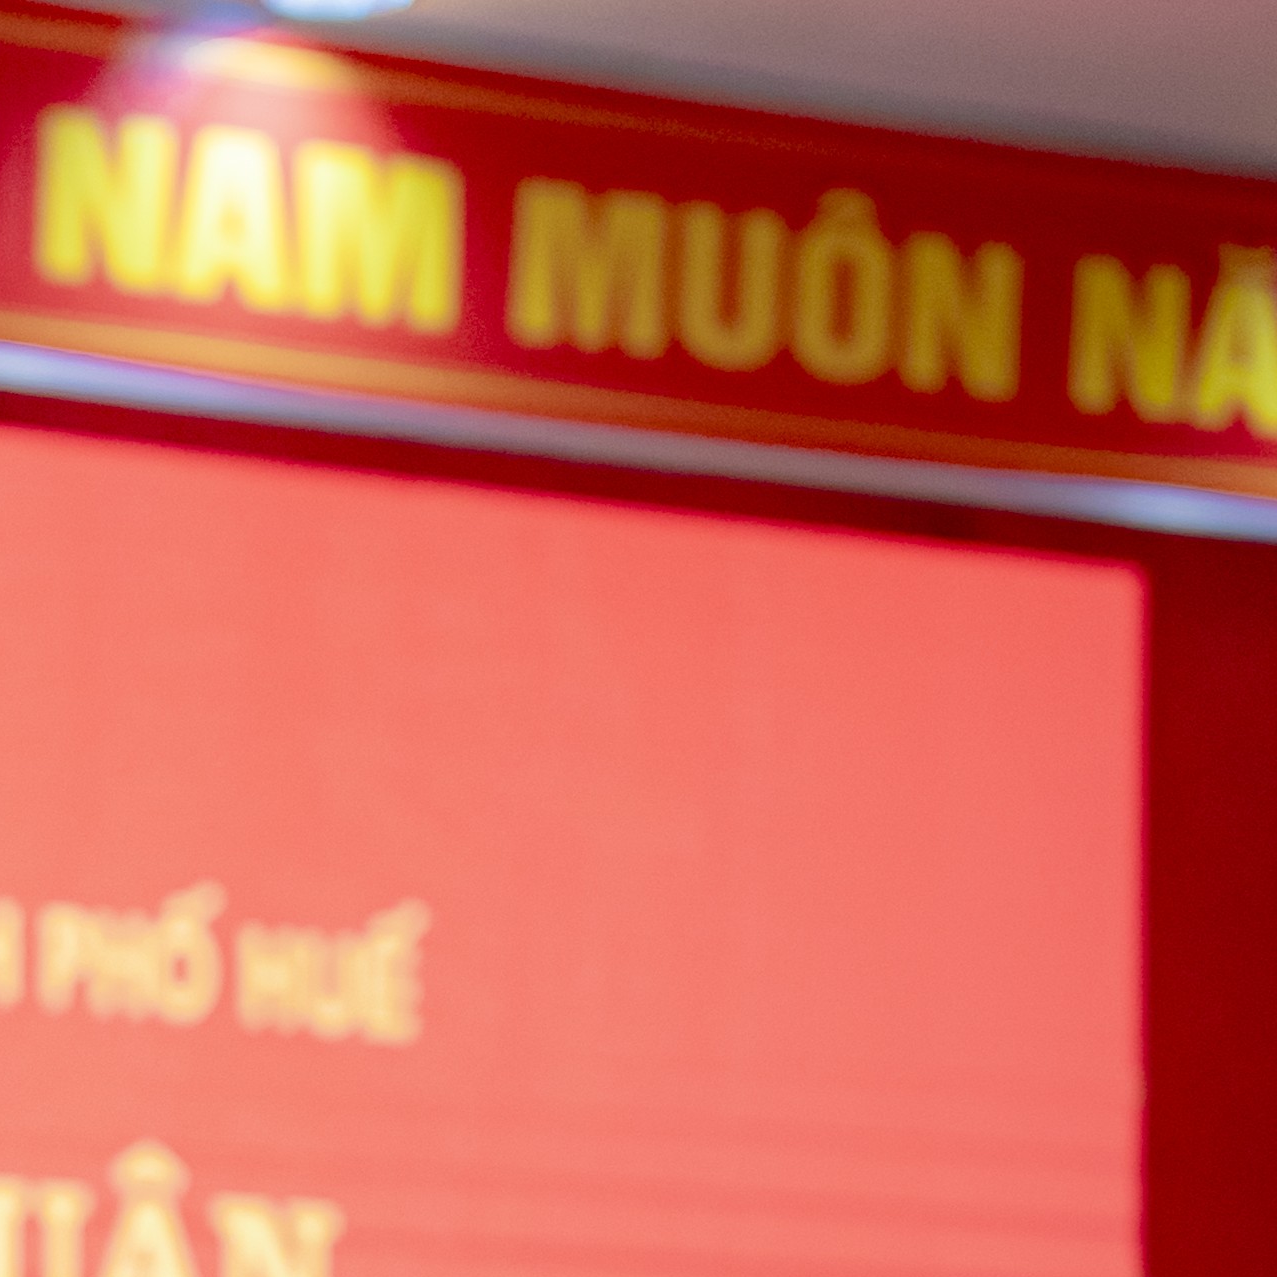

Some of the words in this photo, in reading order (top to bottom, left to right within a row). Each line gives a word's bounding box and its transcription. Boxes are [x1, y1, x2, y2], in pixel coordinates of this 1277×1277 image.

[39, 112, 461, 329] NAM
[512, 181, 1020, 398] MUÔN
[42, 883, 221, 1023] PHỐ
[239, 903, 429, 1040] HUẾ
